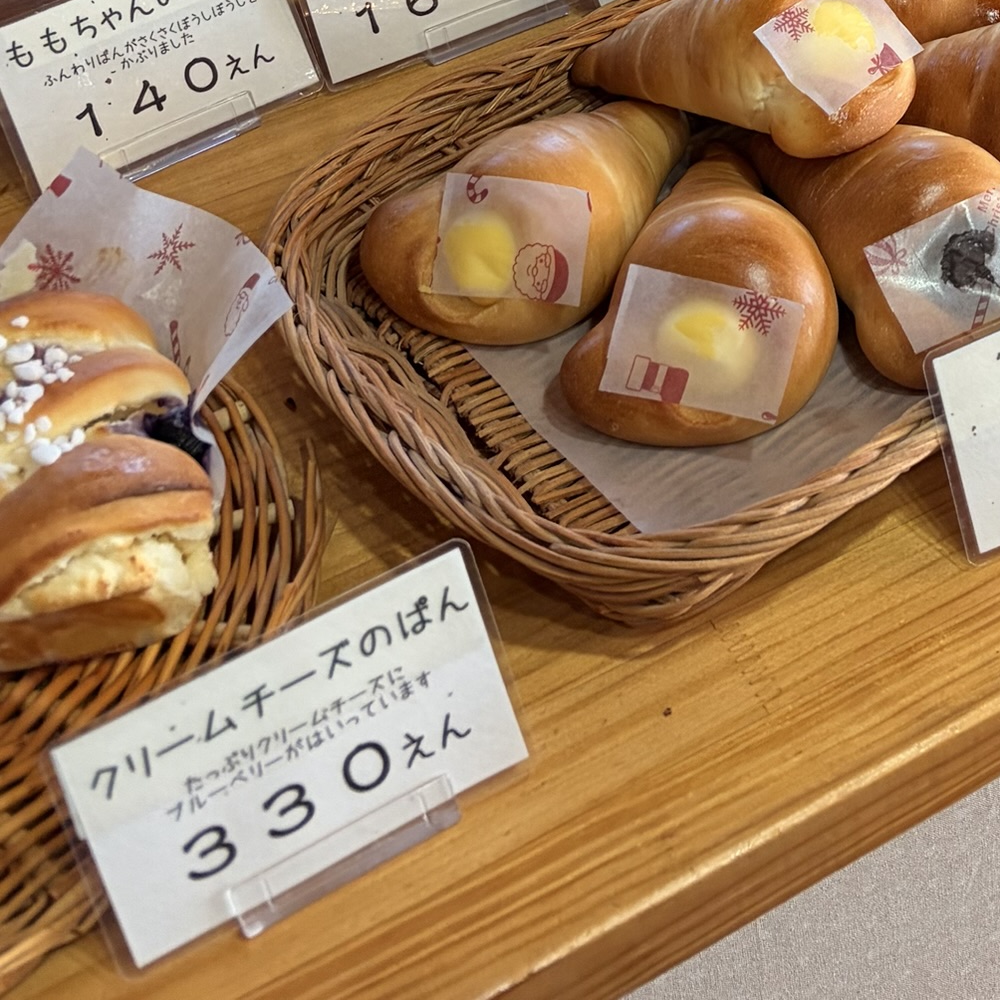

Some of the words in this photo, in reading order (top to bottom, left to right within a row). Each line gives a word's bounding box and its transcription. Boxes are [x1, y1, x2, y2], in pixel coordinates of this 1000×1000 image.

[75, 44, 275, 137] 140えん
[120, 32, 195, 70] かぶりました
[91, 586, 470, 800] クリームチーズのぱん
[184, 665, 406, 794] たっぷりクリームチーズに
[181, 713, 472, 882] 330えん
